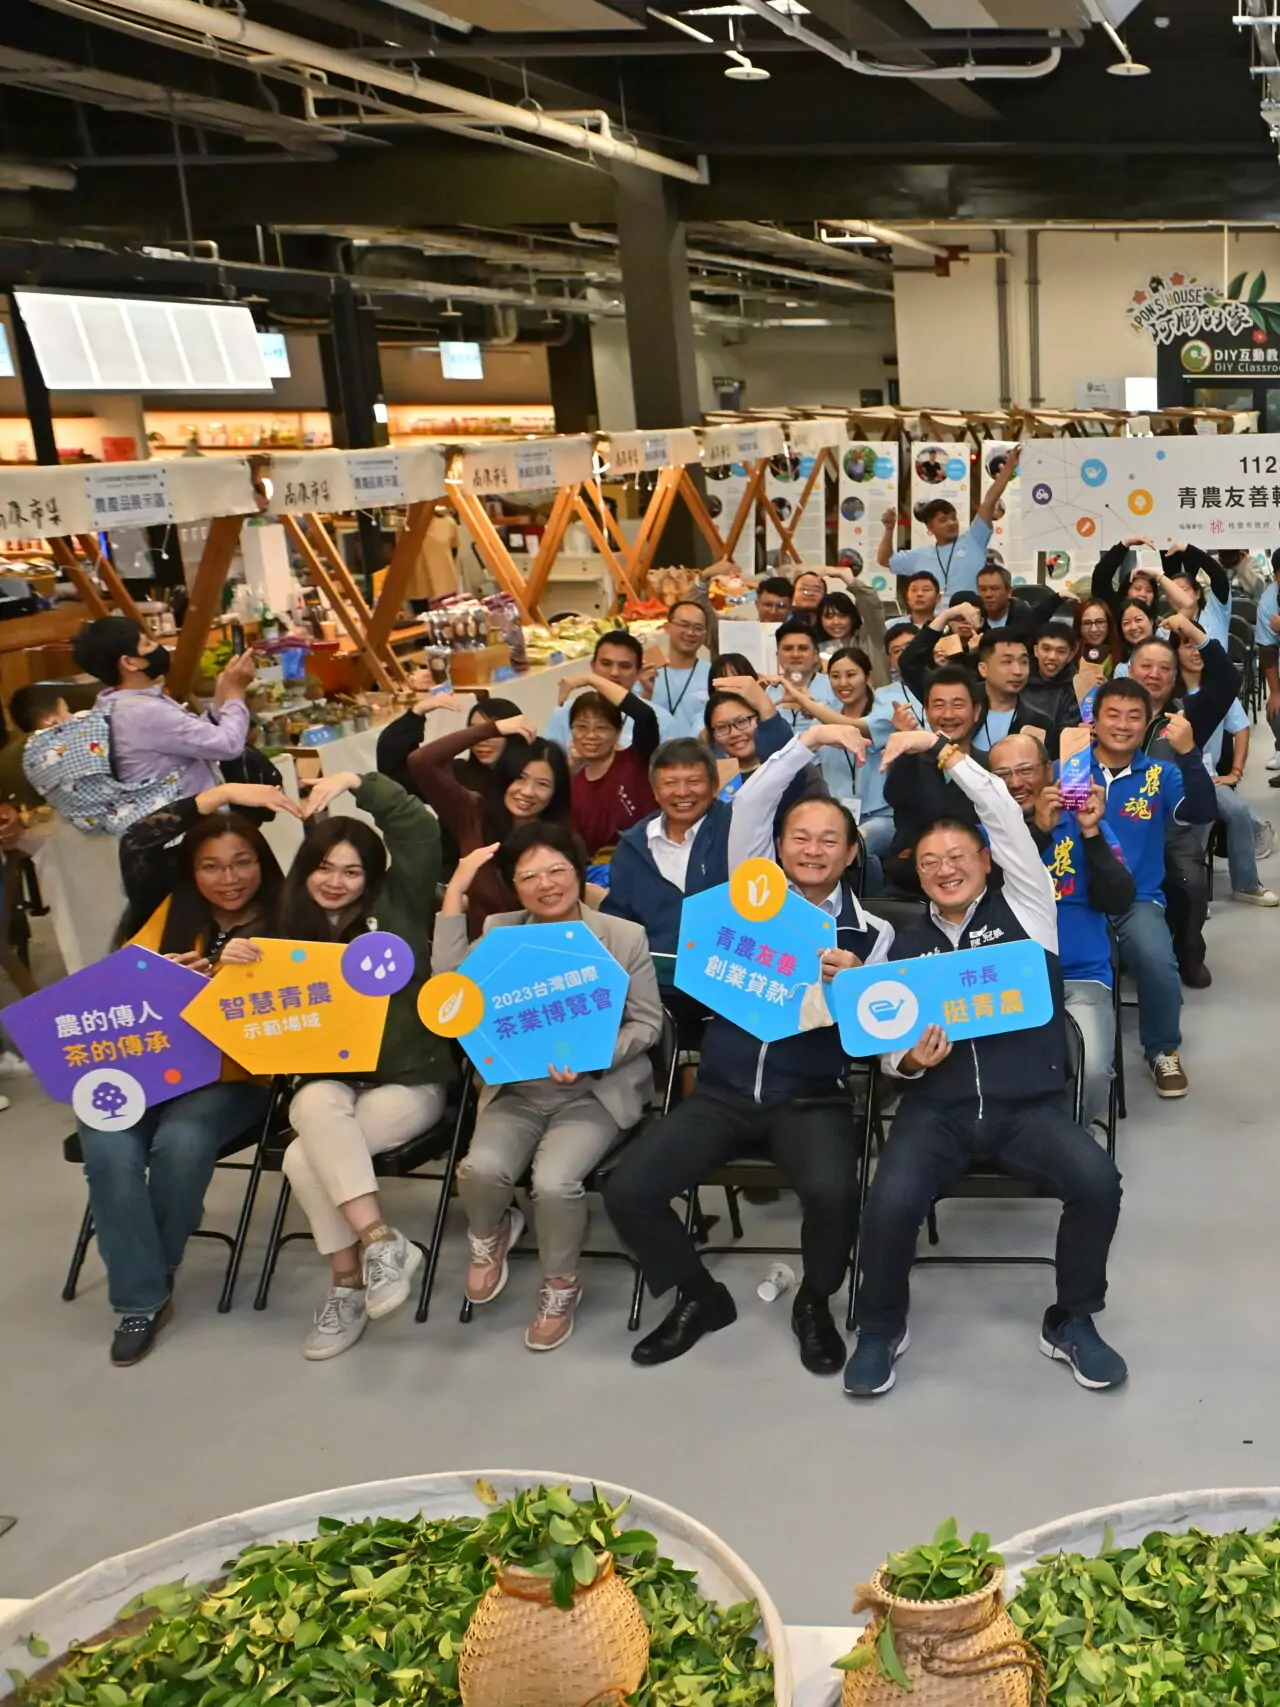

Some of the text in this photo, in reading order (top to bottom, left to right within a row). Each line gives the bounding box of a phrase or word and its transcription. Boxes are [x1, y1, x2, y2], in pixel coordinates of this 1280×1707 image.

[1165, 288, 1202, 308] HOUSE
[1214, 362, 1234, 373] DIY
[716, 926, 798, 977] 青農友善
[492, 965, 599, 1010] 2023台灣國際
[704, 955, 789, 1007] 創業貸款
[958, 965, 999, 988] 市長
[54, 1000, 163, 1039] 農的傳人
[218, 981, 333, 1021] 智慧青農
[493, 987, 613, 1041] 茶業博覽會
[942, 989, 1024, 1026] 挺青農
[243, 1011, 322, 1040] 示範場域
[62, 1030, 171, 1068] 茶的傳承
